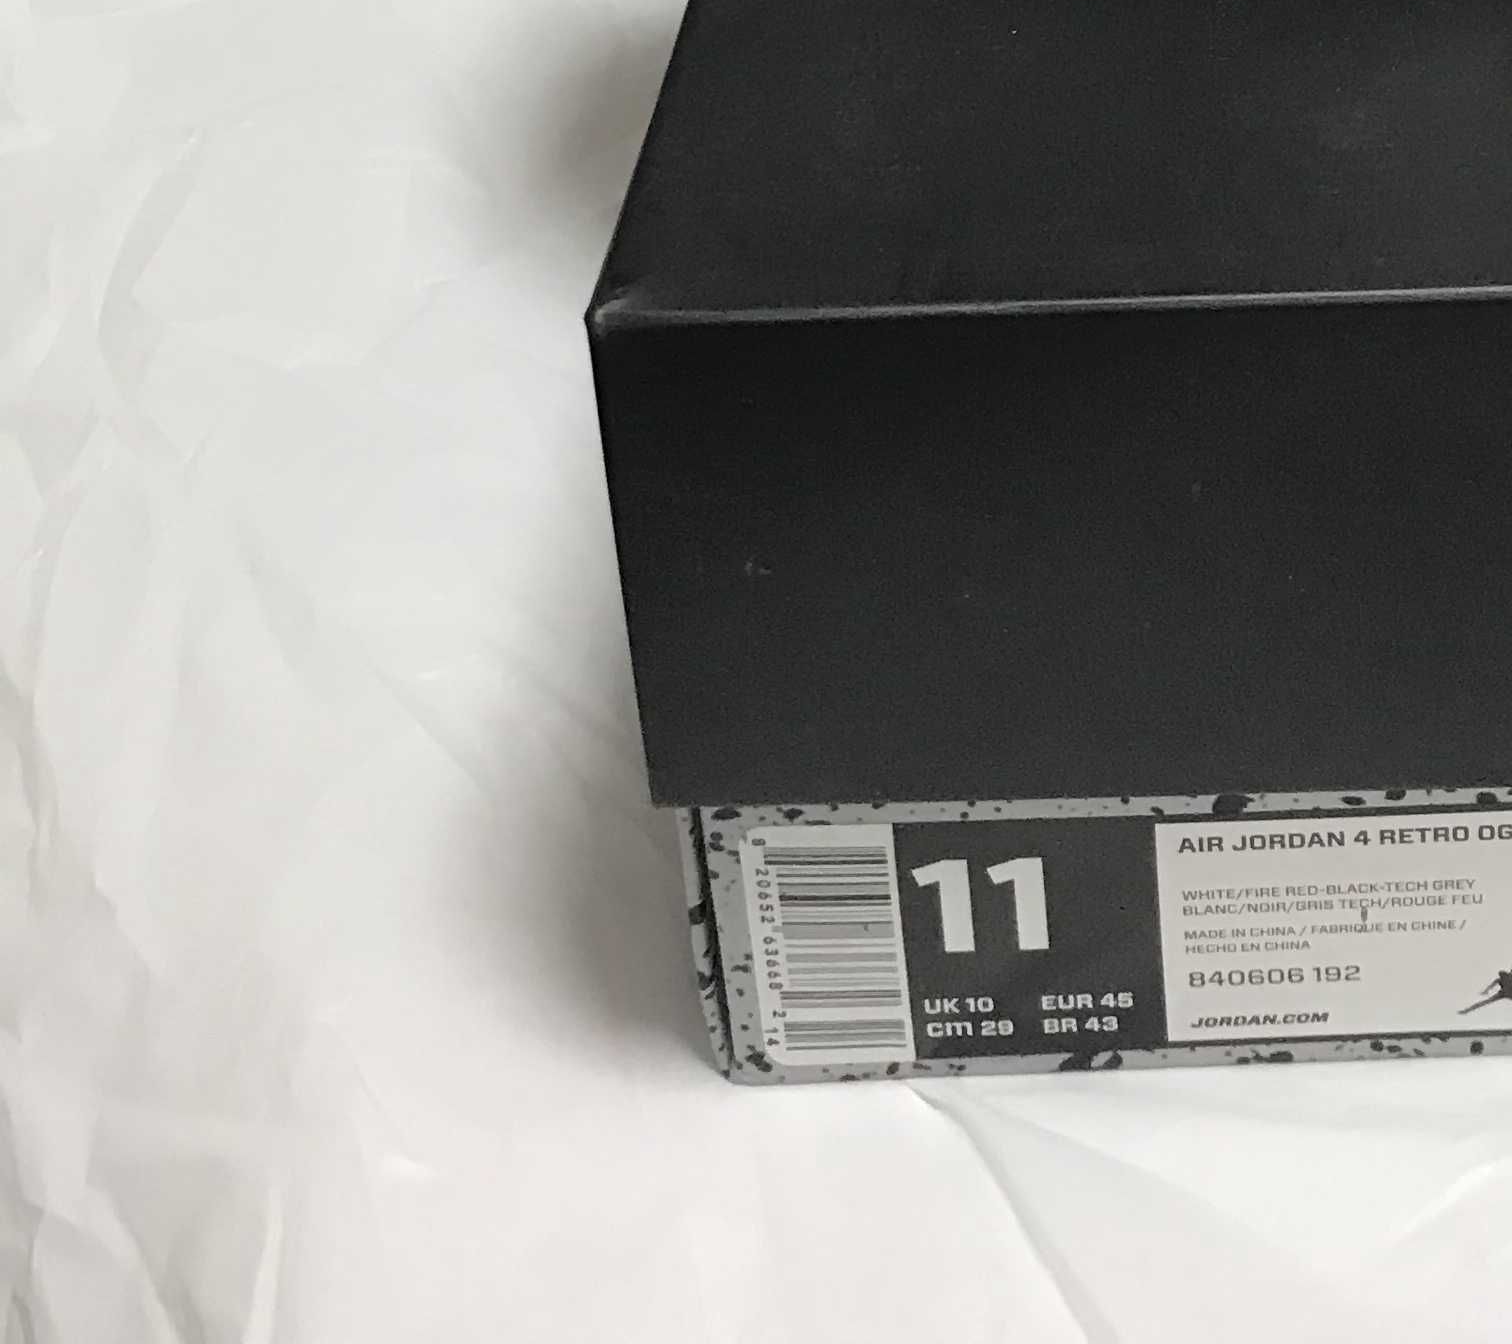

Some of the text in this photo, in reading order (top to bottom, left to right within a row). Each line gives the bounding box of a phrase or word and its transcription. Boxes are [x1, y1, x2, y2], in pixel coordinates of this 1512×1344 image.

[1178, 836, 1224, 854] AIR
[1232, 831, 1345, 852] JORDAN
[1353, 830, 1371, 846] 4
[1379, 826, 1470, 845] RETRO
[1182, 878, 1477, 902] WHITE/FIRE RED-BLACK-TECH GREY
[1451, 894, 1484, 905] FEU
[911, 856, 1050, 953] 11
[1184, 929, 1228, 941] MADE
[1231, 927, 1247, 938] IN
[1249, 926, 1297, 938] CHINA
[1387, 922, 1408, 933] EN
[1411, 920, 1458, 932] CHINE
[1185, 940, 1311, 955] HECHO EN CHINA
[1188, 965, 1361, 988] 840606 192
[923, 996, 995, 1014] UK 10
[1041, 991, 1134, 1011] EUR 45
[1043, 1015, 1119, 1034] BR 43
[1190, 1011, 1330, 1029] JORDAN.COM
